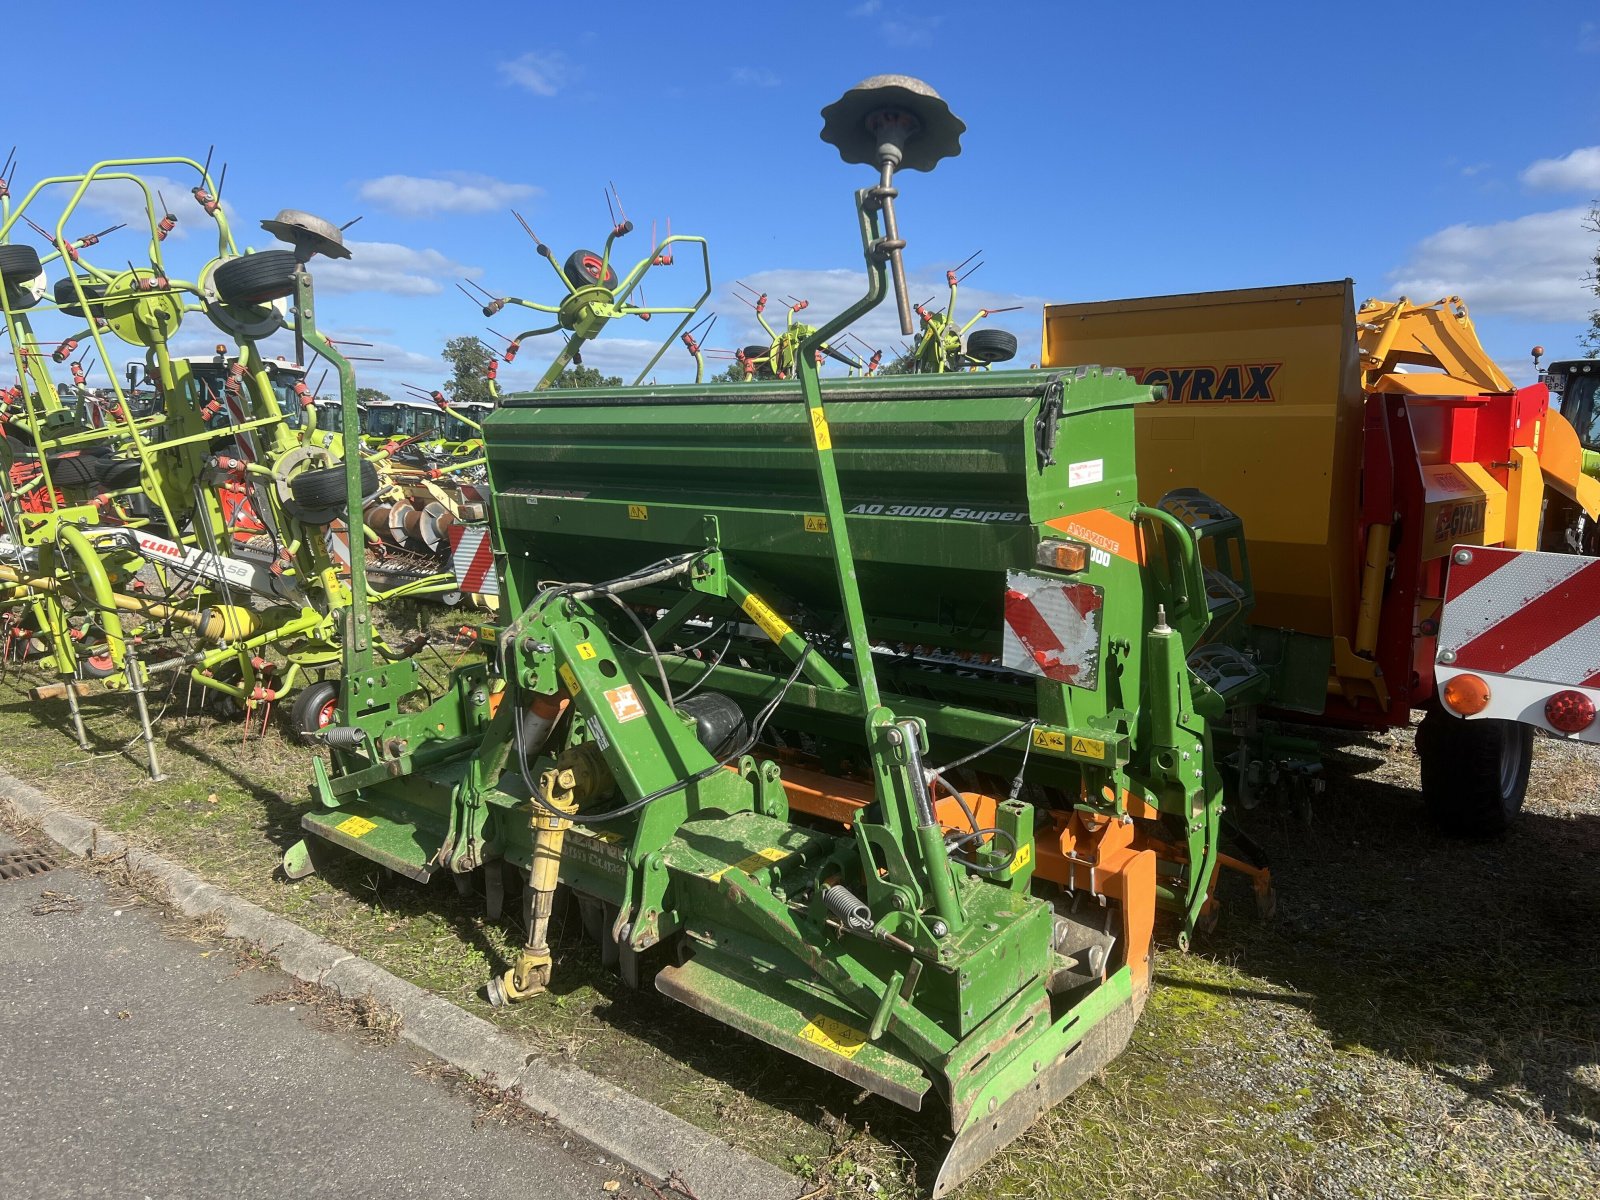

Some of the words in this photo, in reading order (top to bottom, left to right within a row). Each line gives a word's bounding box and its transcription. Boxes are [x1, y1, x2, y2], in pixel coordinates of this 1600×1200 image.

[850, 503, 884, 515] AD
[885, 505, 948, 518] 3000
[950, 507, 1029, 523] Super
[1066, 522, 1120, 553] AMAZONE
[226, 564, 248, 577] 58
